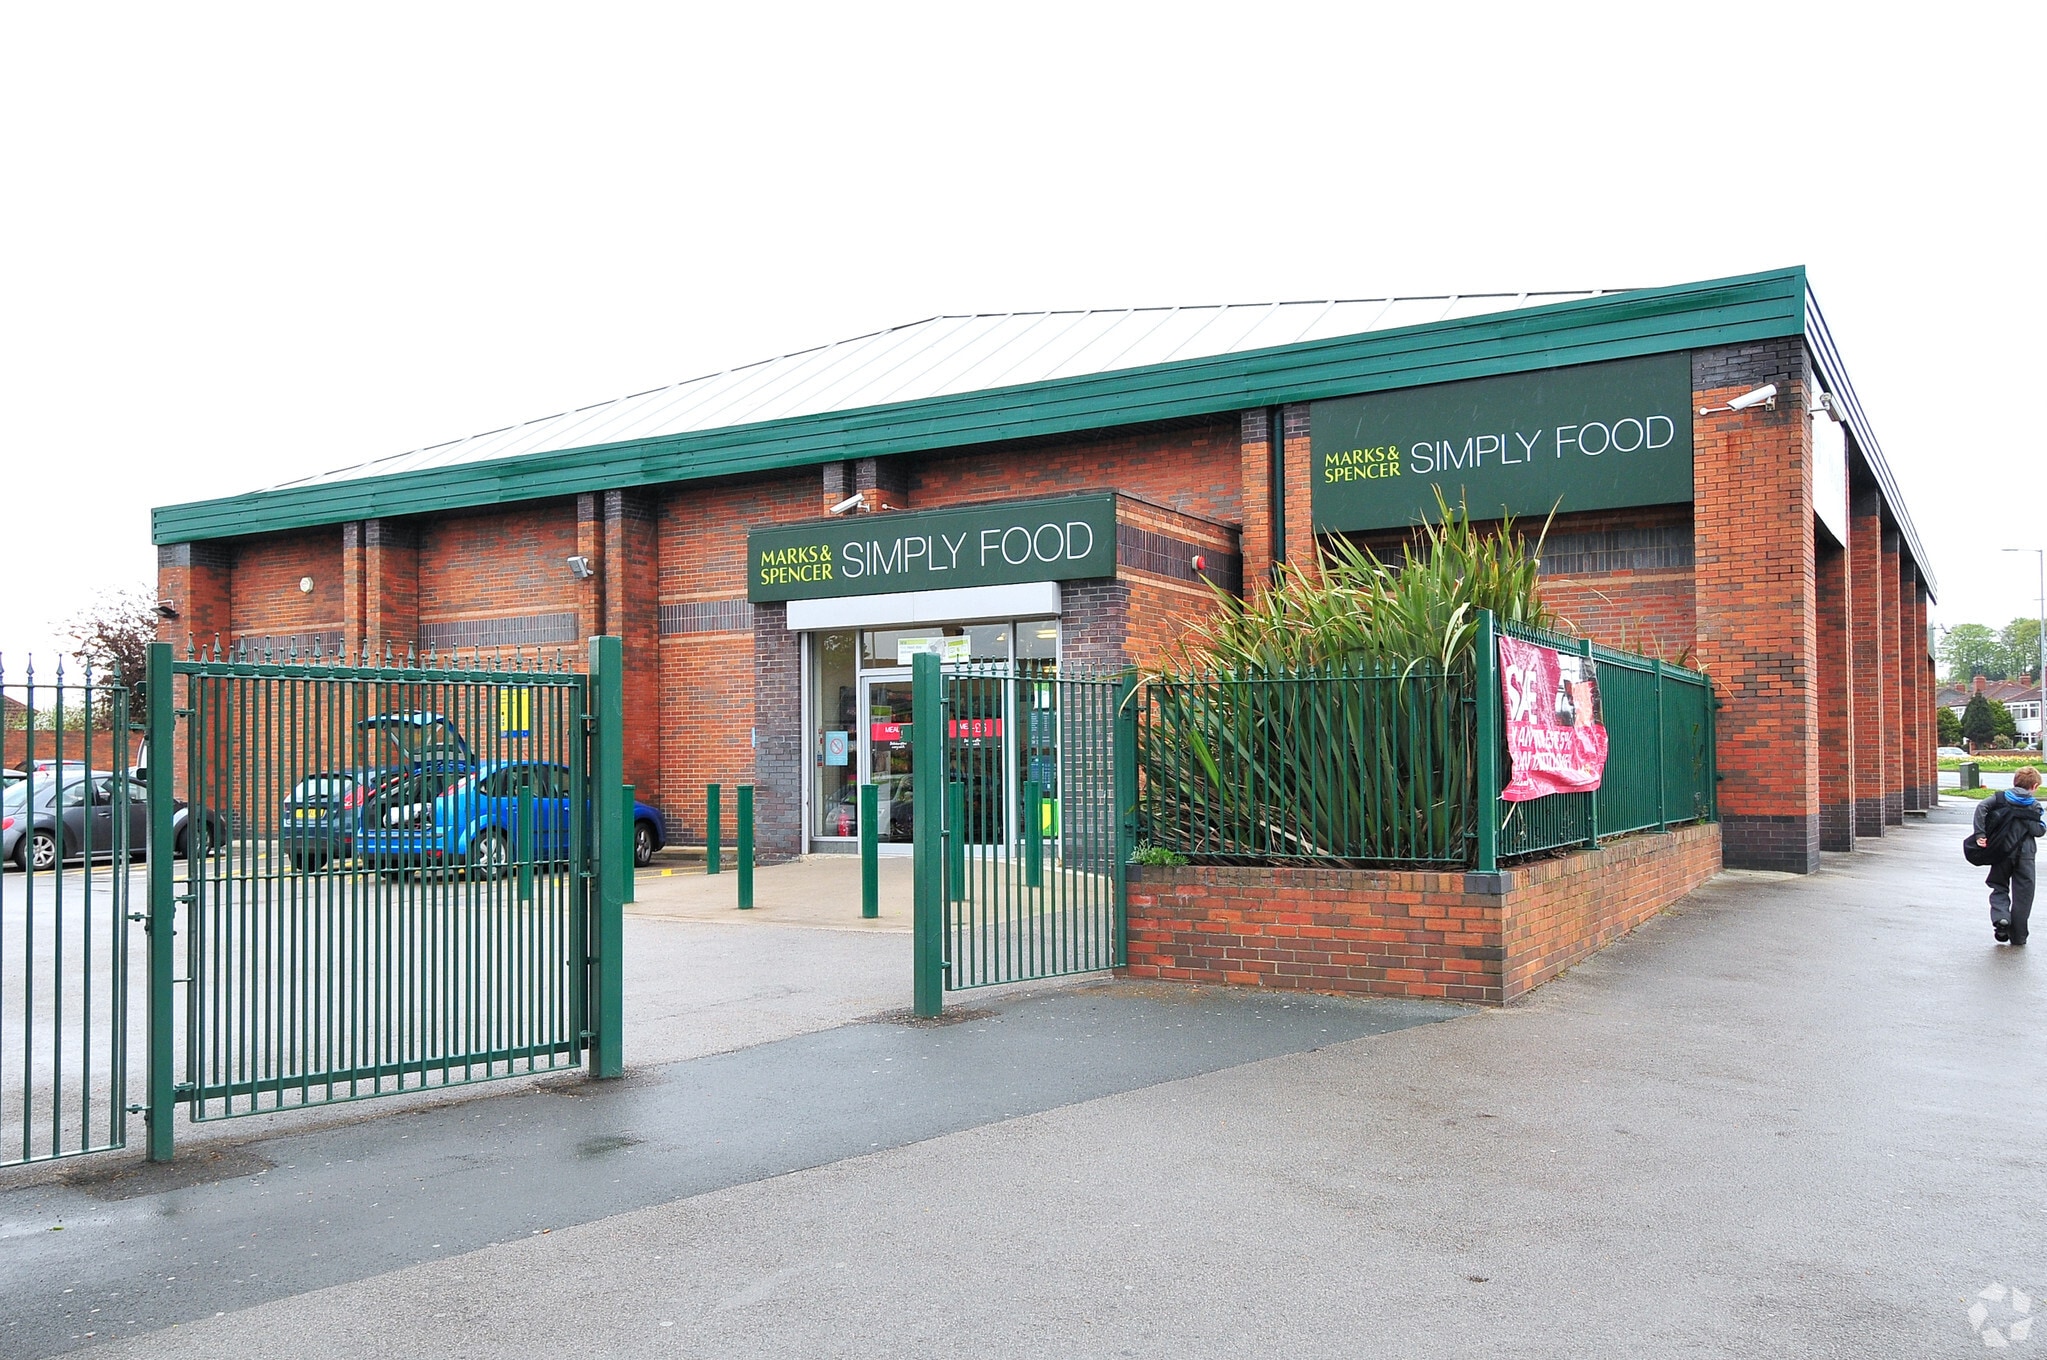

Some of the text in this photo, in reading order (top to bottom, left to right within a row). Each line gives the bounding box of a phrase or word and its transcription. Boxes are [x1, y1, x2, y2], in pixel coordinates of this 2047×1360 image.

[1410, 415, 1675, 474] SIMPLY FOOD
[1325, 461, 1401, 484] SPENCER
[842, 521, 1094, 578] SIMPLY FOOD
[761, 563, 833, 585] SPENCER
